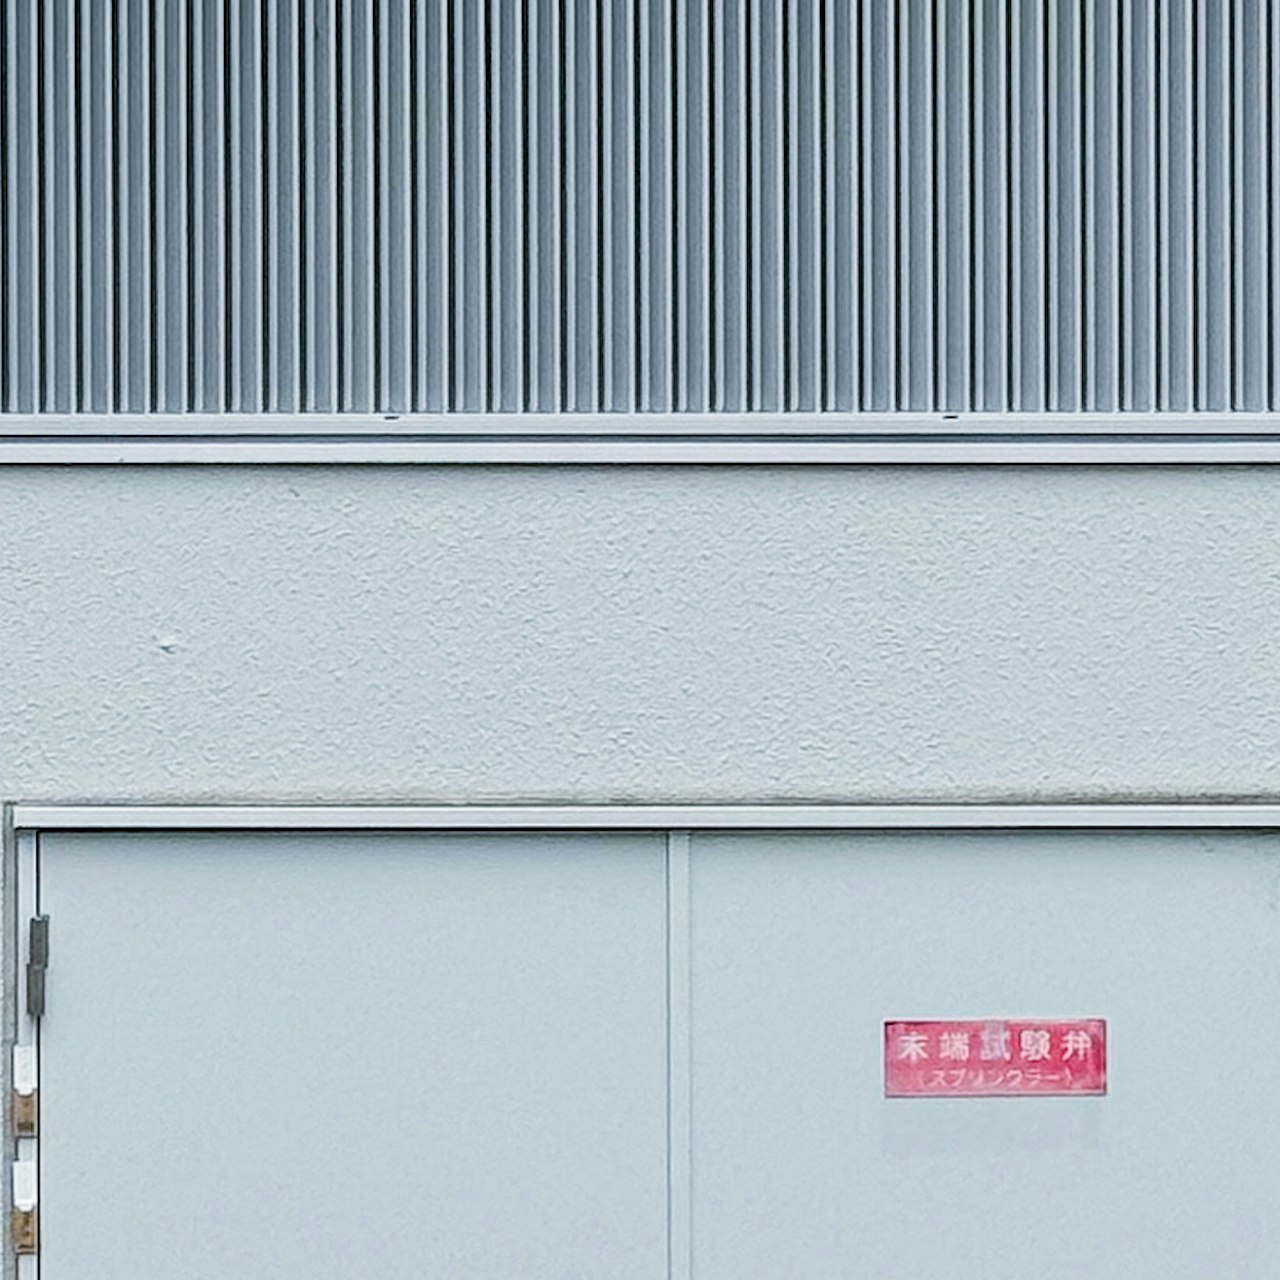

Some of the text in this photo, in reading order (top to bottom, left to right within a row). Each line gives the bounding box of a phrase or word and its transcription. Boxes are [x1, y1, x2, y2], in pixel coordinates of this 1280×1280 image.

[897, 1029, 1093, 1063] 末端試験弁
